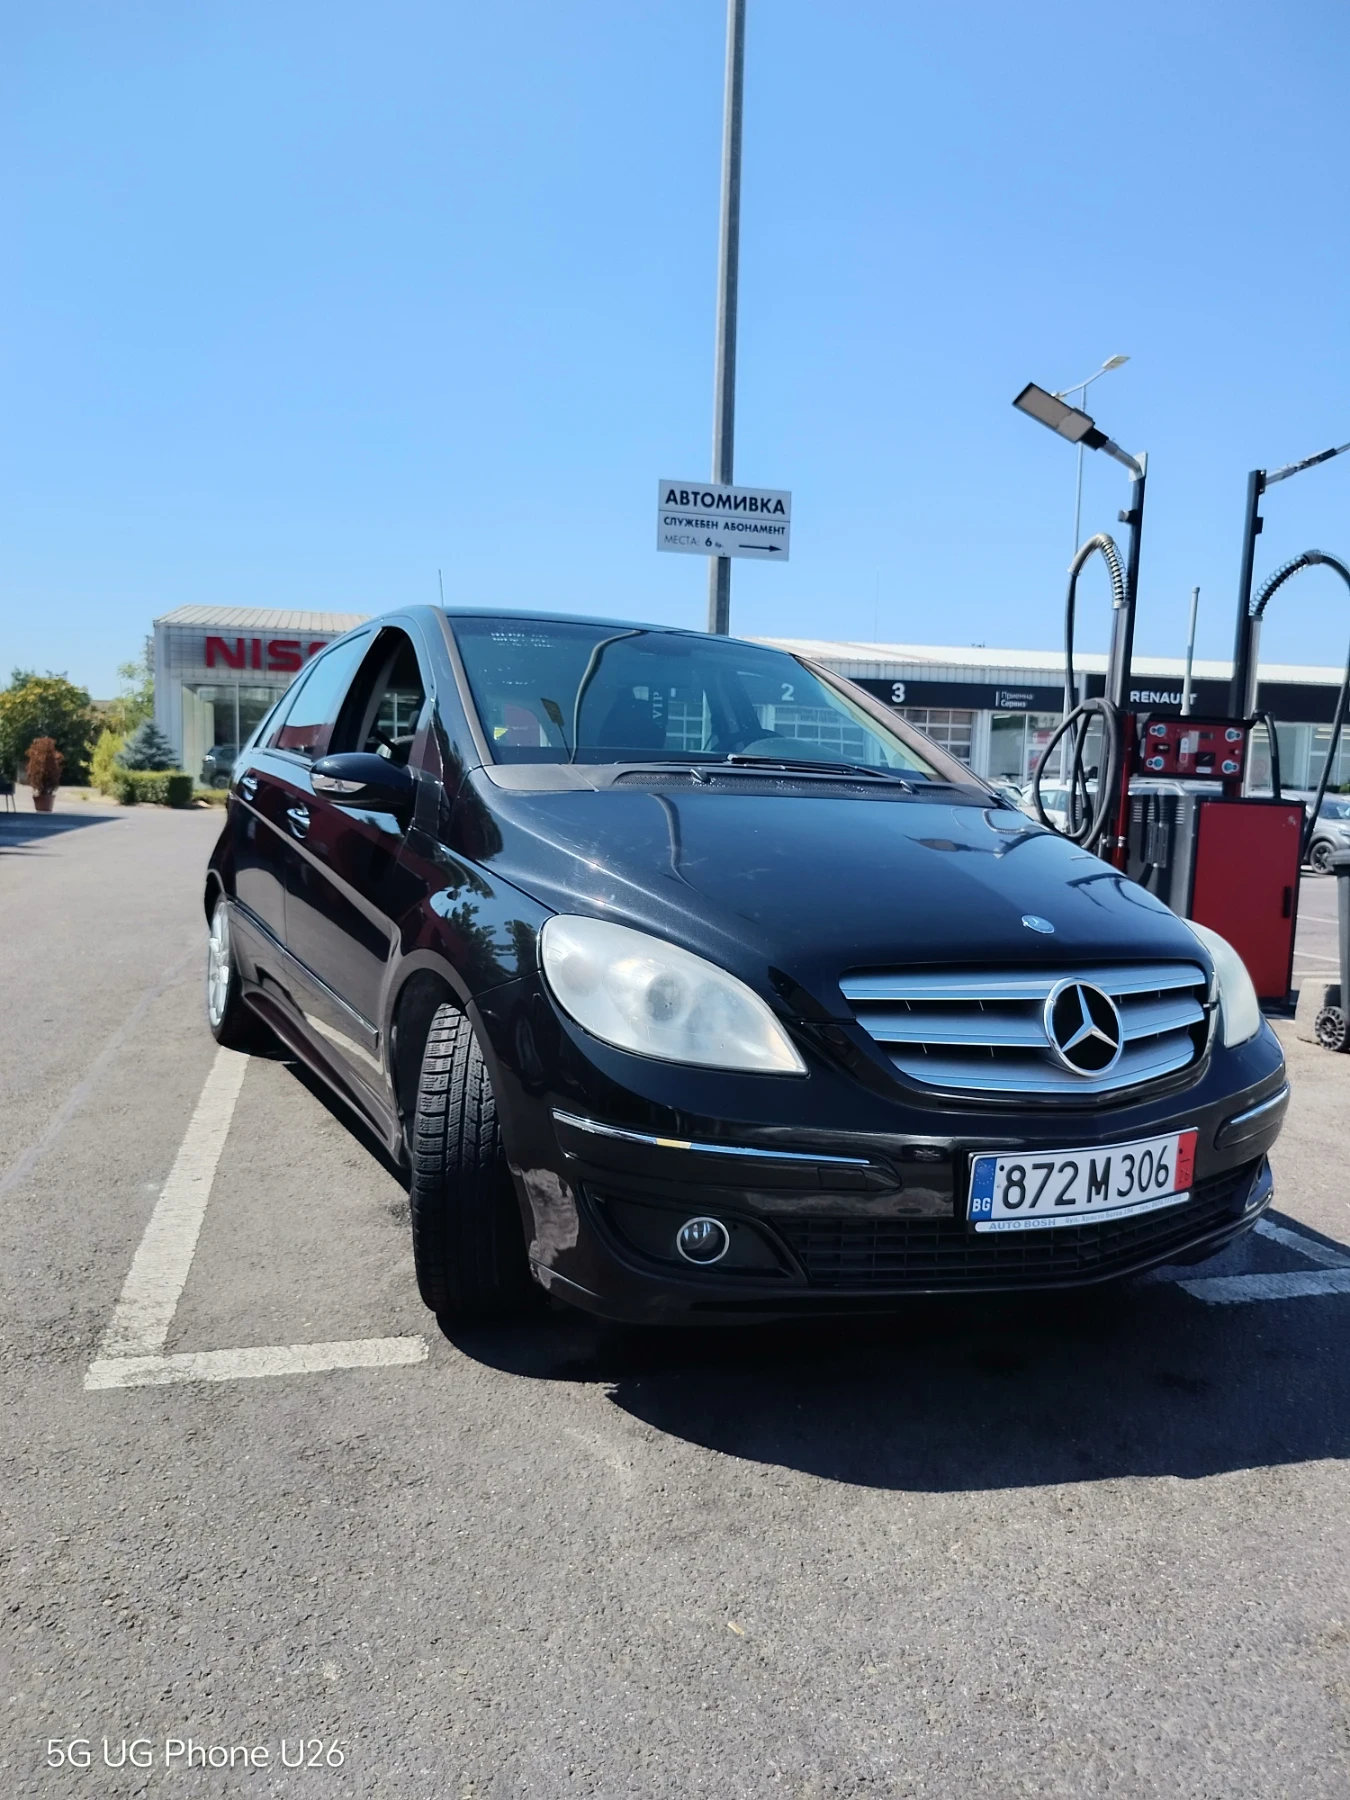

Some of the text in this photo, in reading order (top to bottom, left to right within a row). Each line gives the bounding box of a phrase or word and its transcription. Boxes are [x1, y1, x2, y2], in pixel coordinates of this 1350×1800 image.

[665, 489, 785, 515] АВТОМИВКА
[664, 516, 785, 536] СЛУЖЕБЕН АБОНАМЕНТ
[705, 537, 712, 547] 6
[781, 683, 795, 701] 2
[891, 683, 905, 702] 3
[972, 1197, 991, 1212] BG
[988, 1219, 1056, 1231] AUTO BOSH
